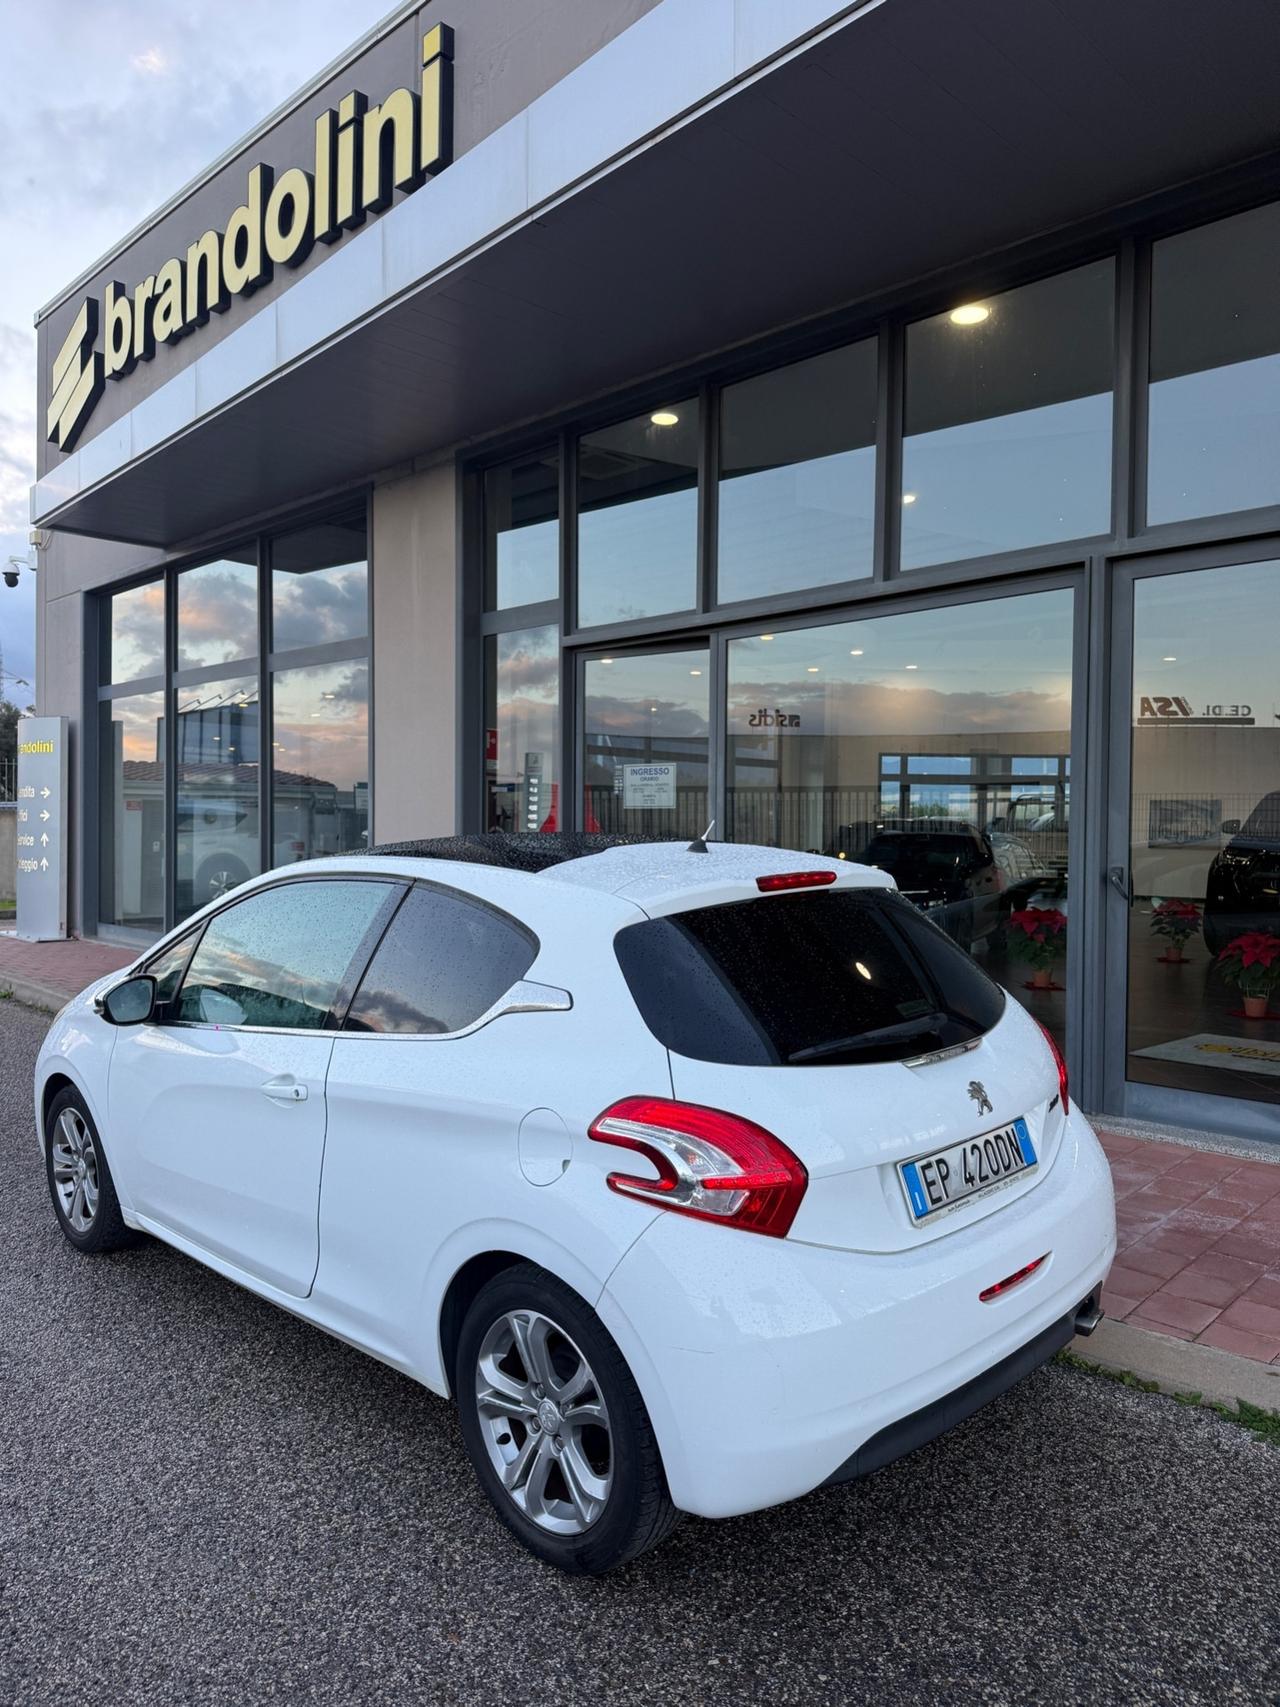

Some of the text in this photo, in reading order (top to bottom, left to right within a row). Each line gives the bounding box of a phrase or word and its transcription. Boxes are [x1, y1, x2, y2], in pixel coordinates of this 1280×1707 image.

[104, 22, 455, 382] brandolini
[630, 767, 670, 776] INGRESSO
[920, 1158, 950, 1206] EP
[962, 1128, 1024, 1188] 420DN
